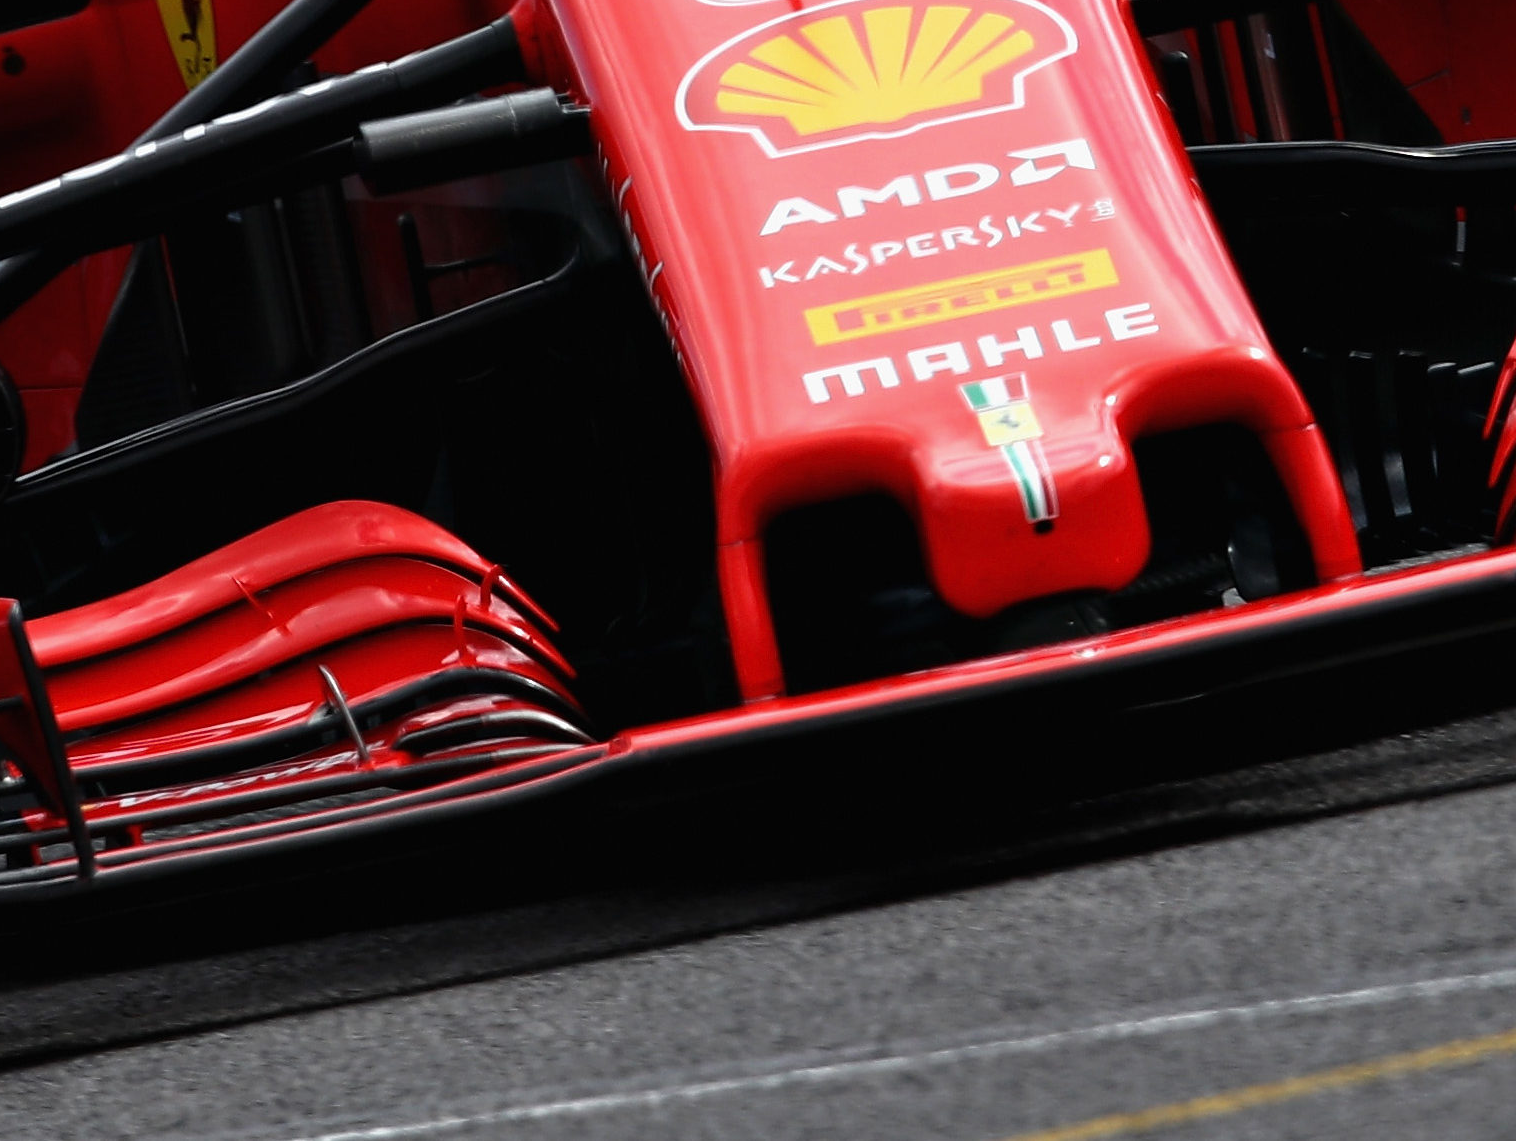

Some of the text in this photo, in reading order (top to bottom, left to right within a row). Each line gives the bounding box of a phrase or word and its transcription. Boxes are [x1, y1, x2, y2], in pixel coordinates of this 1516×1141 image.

[760, 163, 1000, 236] AMD
[759, 202, 1082, 288] KASPERSKY
[834, 262, 1087, 334] PIRELLI
[802, 303, 1160, 404] MAHLE
